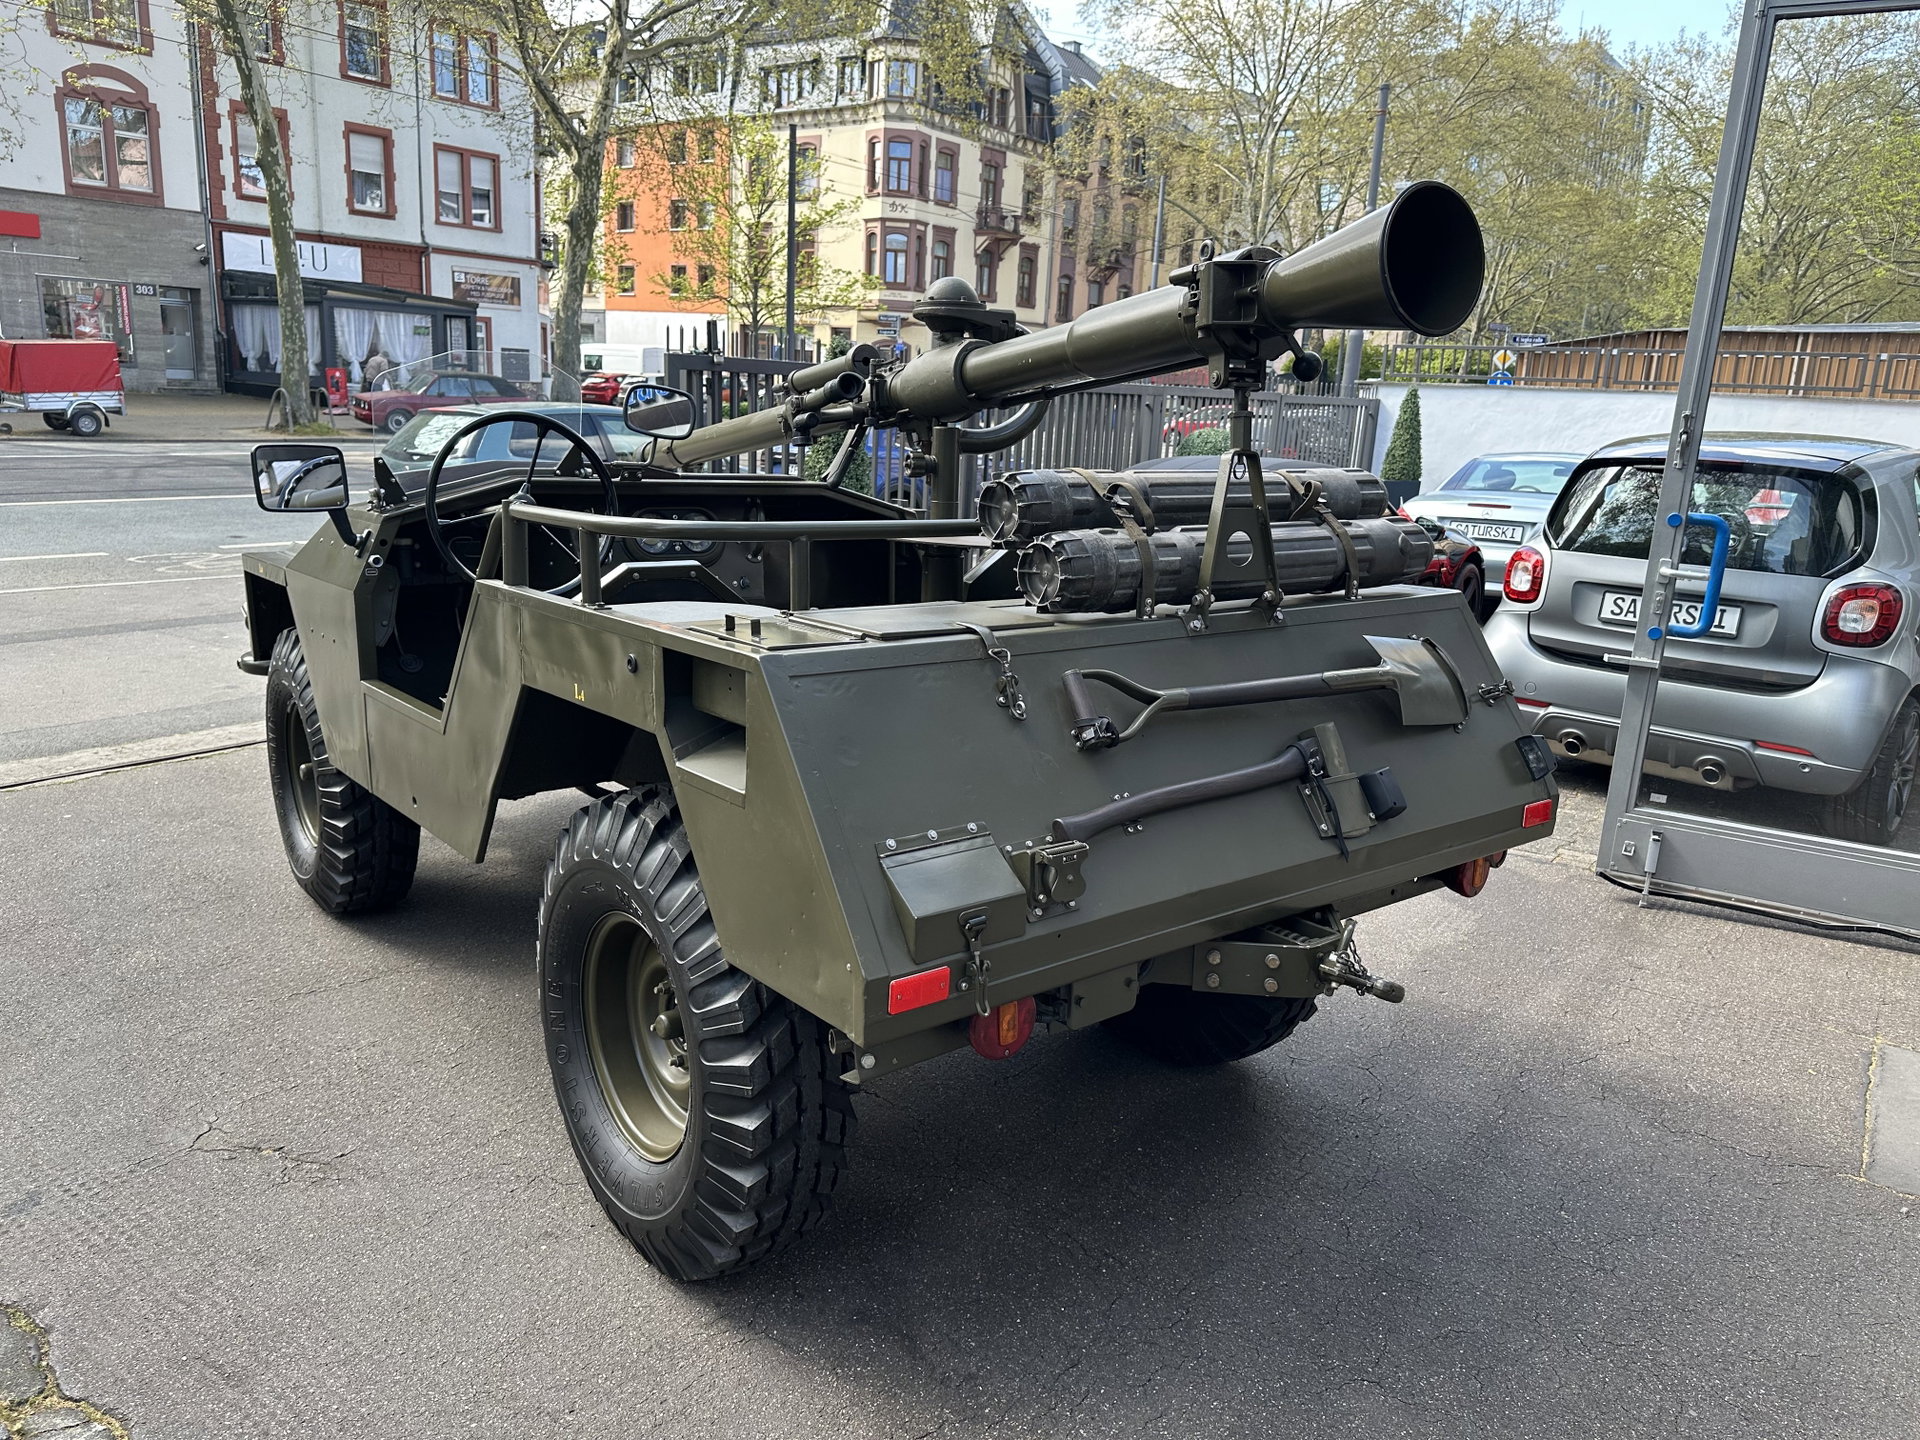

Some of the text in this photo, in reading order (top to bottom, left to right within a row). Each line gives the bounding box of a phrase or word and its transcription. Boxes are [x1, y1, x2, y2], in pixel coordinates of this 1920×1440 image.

[465, 275, 489, 285] TORRE
[135, 284, 154, 295] 303
[1610, 596, 1727, 630] SARSI
